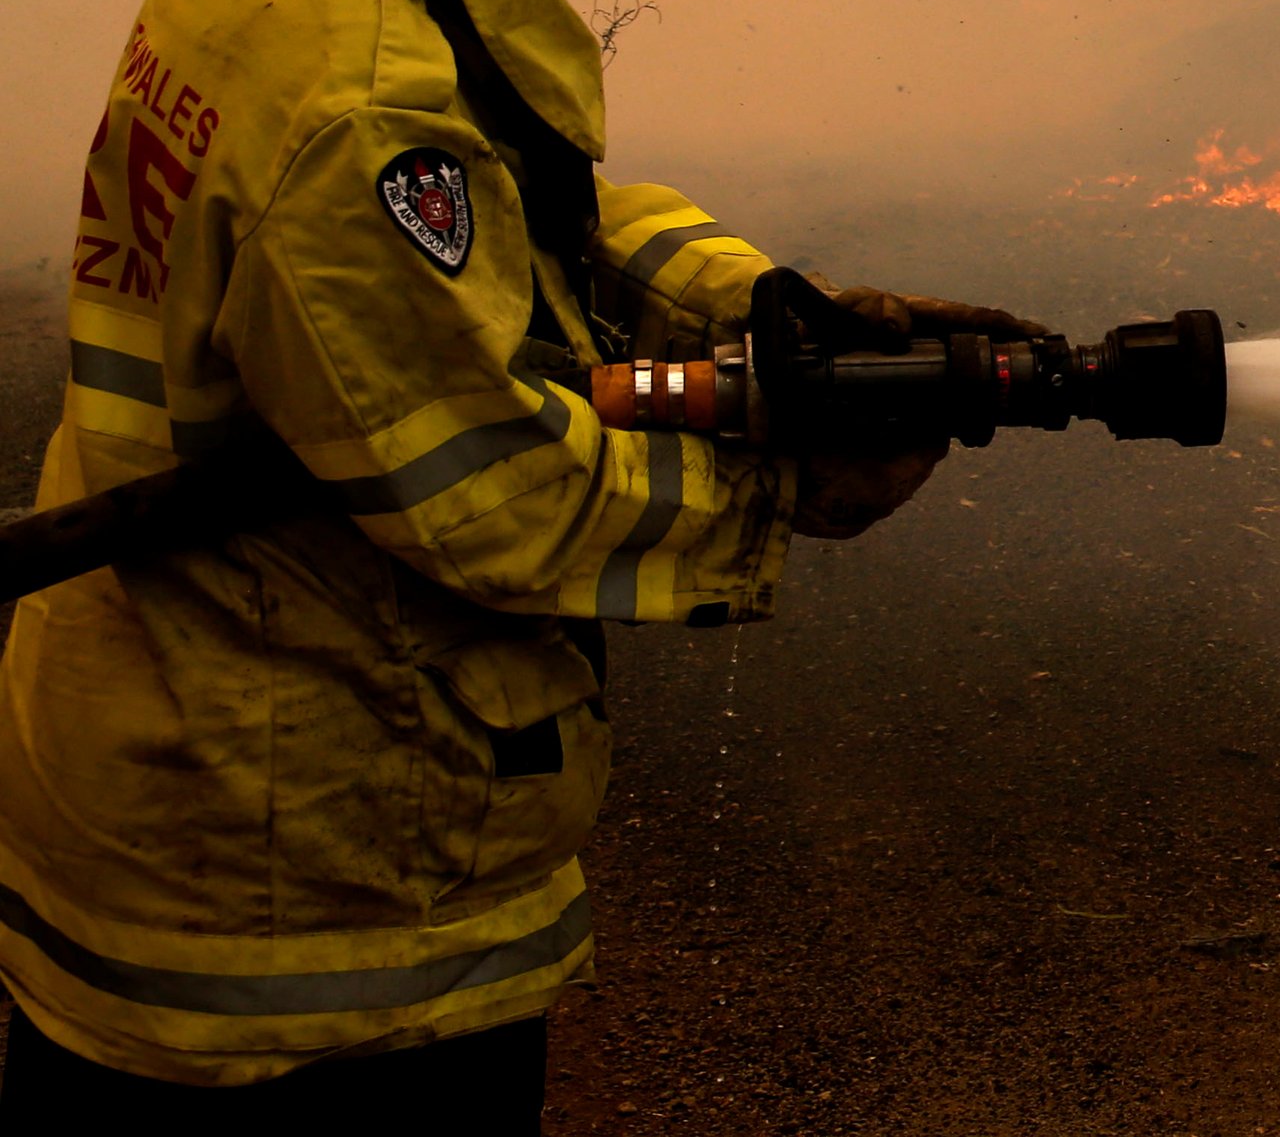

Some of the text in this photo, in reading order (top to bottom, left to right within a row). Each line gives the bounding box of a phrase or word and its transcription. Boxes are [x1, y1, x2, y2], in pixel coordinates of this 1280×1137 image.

[123, 42, 220, 158] WALES
[386, 185, 449, 257] FIRE AND RESCUE
